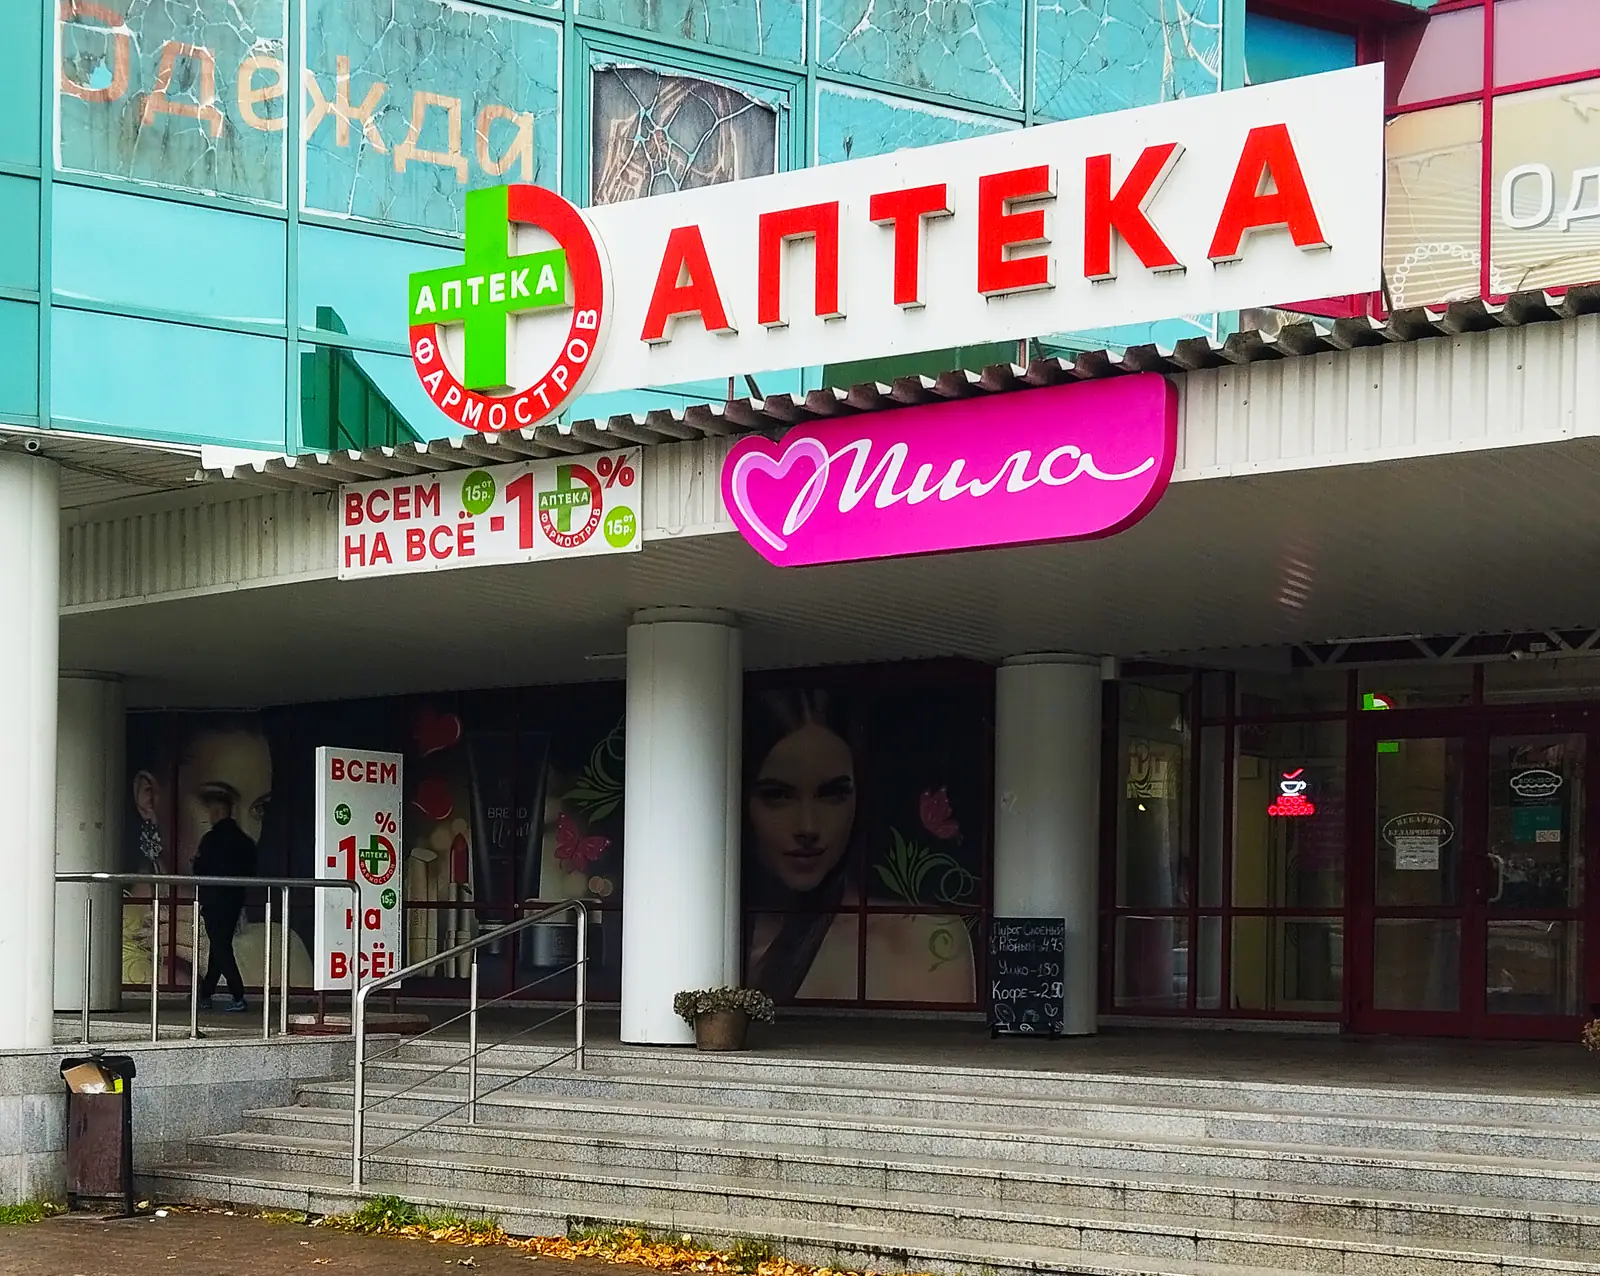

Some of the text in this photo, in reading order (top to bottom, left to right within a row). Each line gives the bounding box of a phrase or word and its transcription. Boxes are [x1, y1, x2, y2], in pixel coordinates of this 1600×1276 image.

[640, 122, 1332, 345] АПТЕКА
[415, 264, 558, 315] АПТЕКА
[415, 308, 598, 430] ФАРМОСТРОВ
[345, 482, 441, 527] ВСЕМ
[540, 491, 589, 507] АПТЕКА
[783, 437, 1156, 535] Мила
[344, 510, 476, 568] НА ВСЁ
[540, 507, 601, 547] ФАРМОСТРОВ
[331, 758, 397, 785] ВСЕМ
